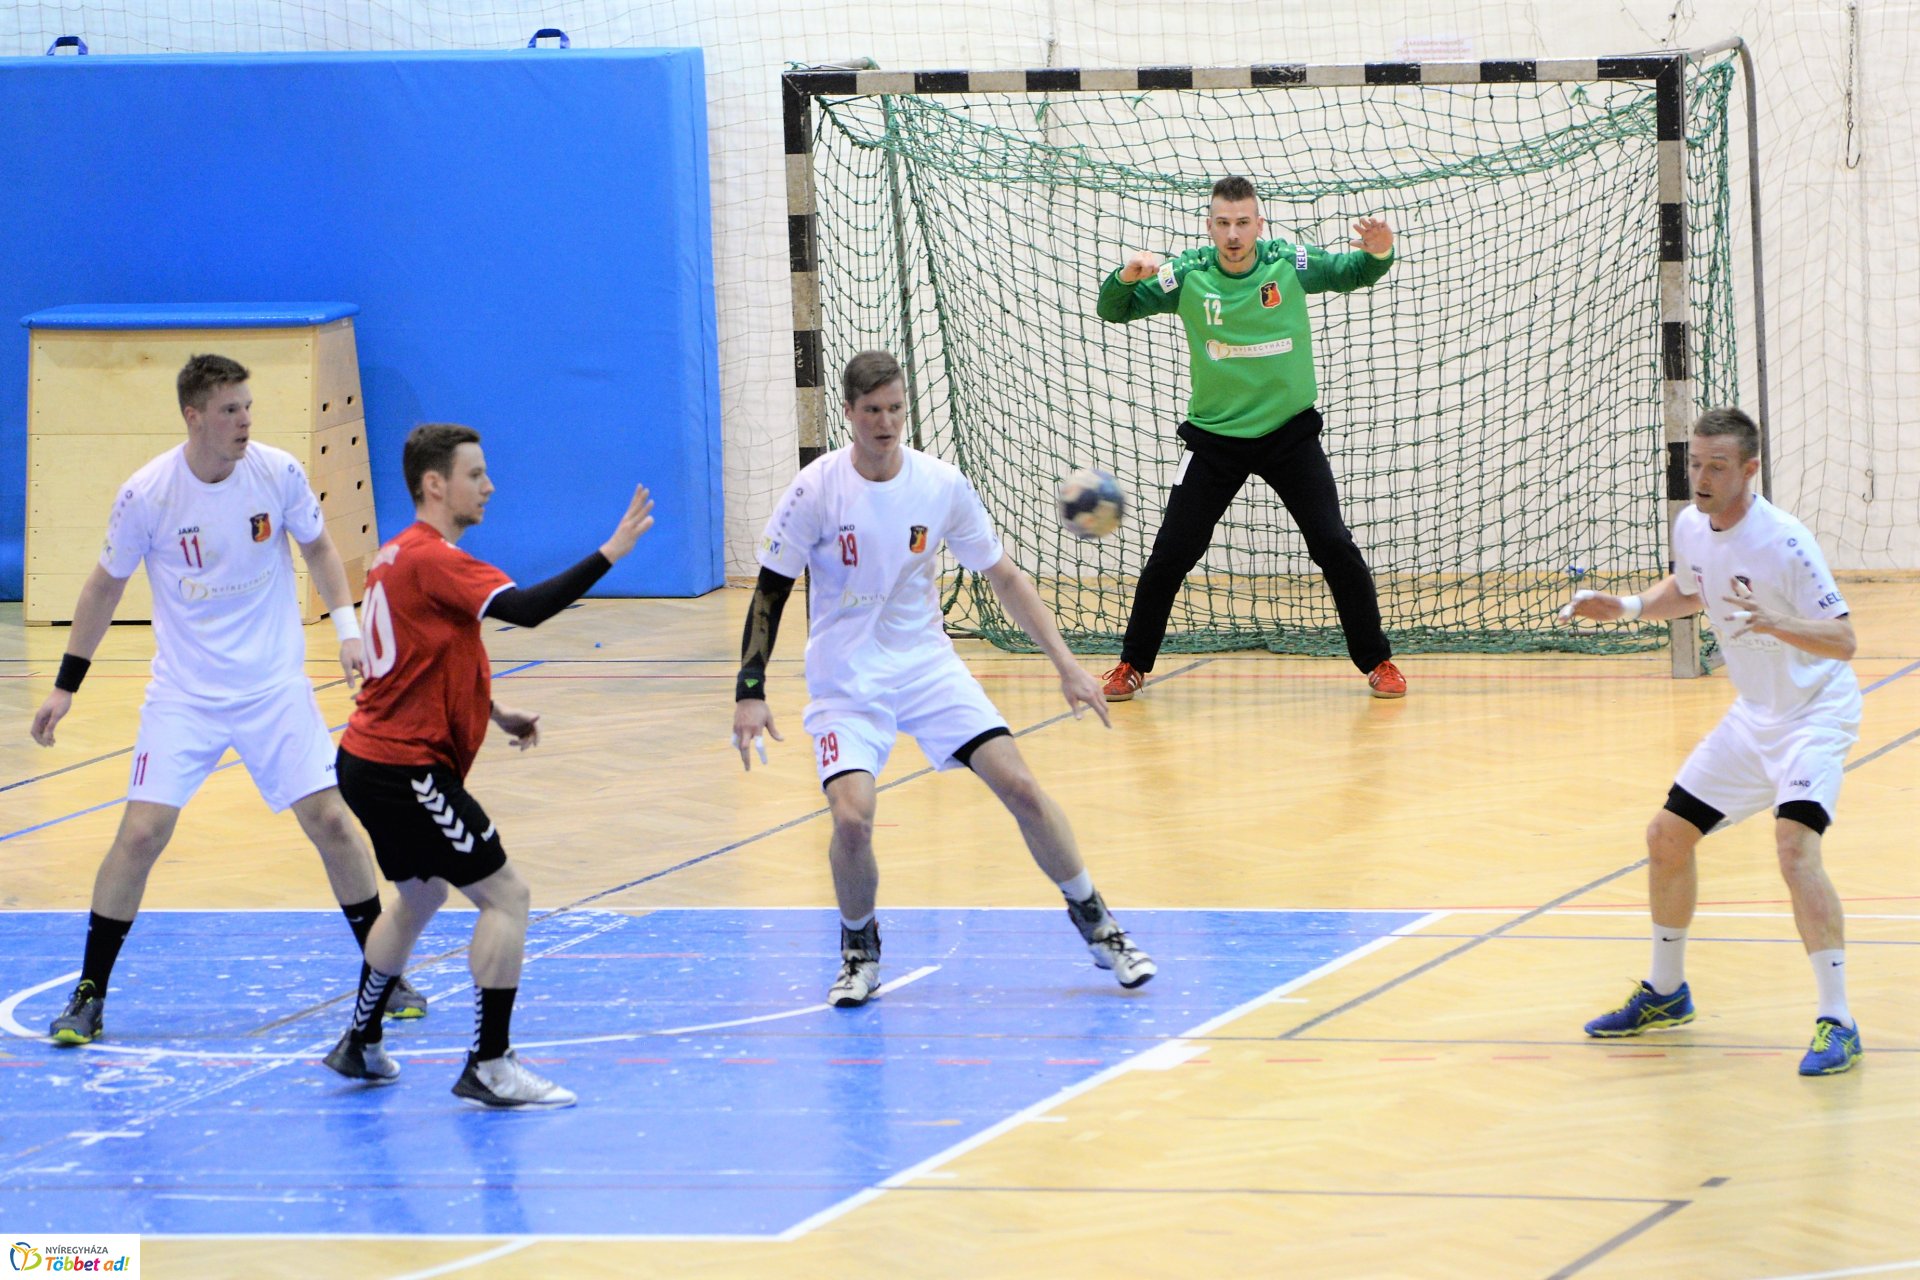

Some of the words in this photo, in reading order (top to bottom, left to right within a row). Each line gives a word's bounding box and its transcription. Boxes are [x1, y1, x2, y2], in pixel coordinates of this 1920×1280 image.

[1203, 299, 1223, 325] 12
[178, 526, 200, 535] JAKO
[179, 535, 203, 568] 11
[820, 731, 839, 767] 29
[133, 752, 148, 786] 11
[1789, 779, 1811, 788] JAKO
